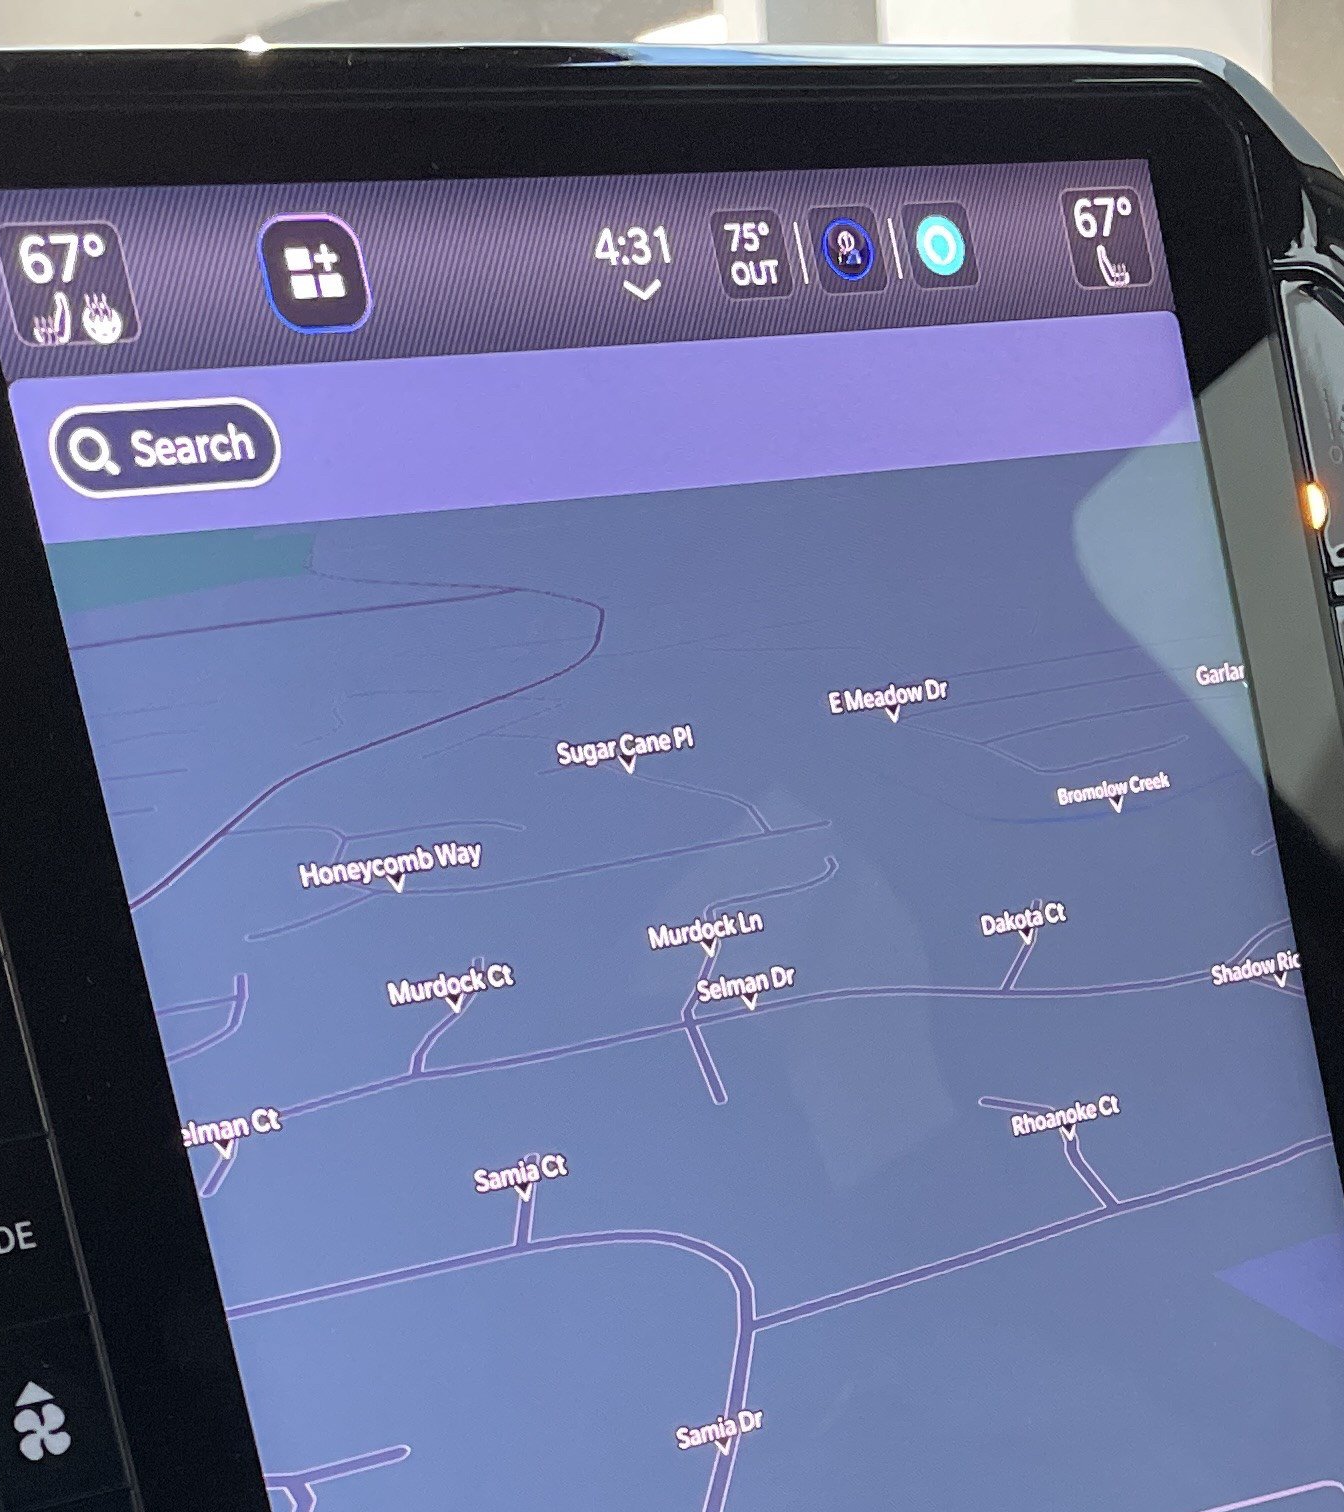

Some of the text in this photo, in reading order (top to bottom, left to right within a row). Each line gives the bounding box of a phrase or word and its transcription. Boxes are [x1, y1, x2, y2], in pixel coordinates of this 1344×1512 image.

[723, 220, 770, 253] 75°
[1072, 195, 1132, 239] 67°
[17, 232, 105, 284] 67°
[593, 224, 673, 268] 4:31
[730, 258, 778, 288] OUT
[129, 421, 256, 468] Search
[828, 678, 949, 715] E Meadow Dr
[556, 737, 616, 769] Sugar
[619, 731, 671, 757] Cane
[1057, 770, 1170, 806] Bromolow Creek
[298, 841, 482, 888] Honeycomb Way
[647, 911, 764, 950] Murdock Ln
[981, 903, 1067, 937] Dakota Ct
[386, 963, 515, 1007] Murdock Ct
[696, 966, 796, 1003] Selman Dr
[1211, 958, 1275, 985] Shadow
[251, 1108, 281, 1133] Ct
[1011, 1094, 1121, 1137] Rhoanoke Ct
[473, 1153, 568, 1194] Samia Ct
[675, 1408, 764, 1450] Samia Dr
